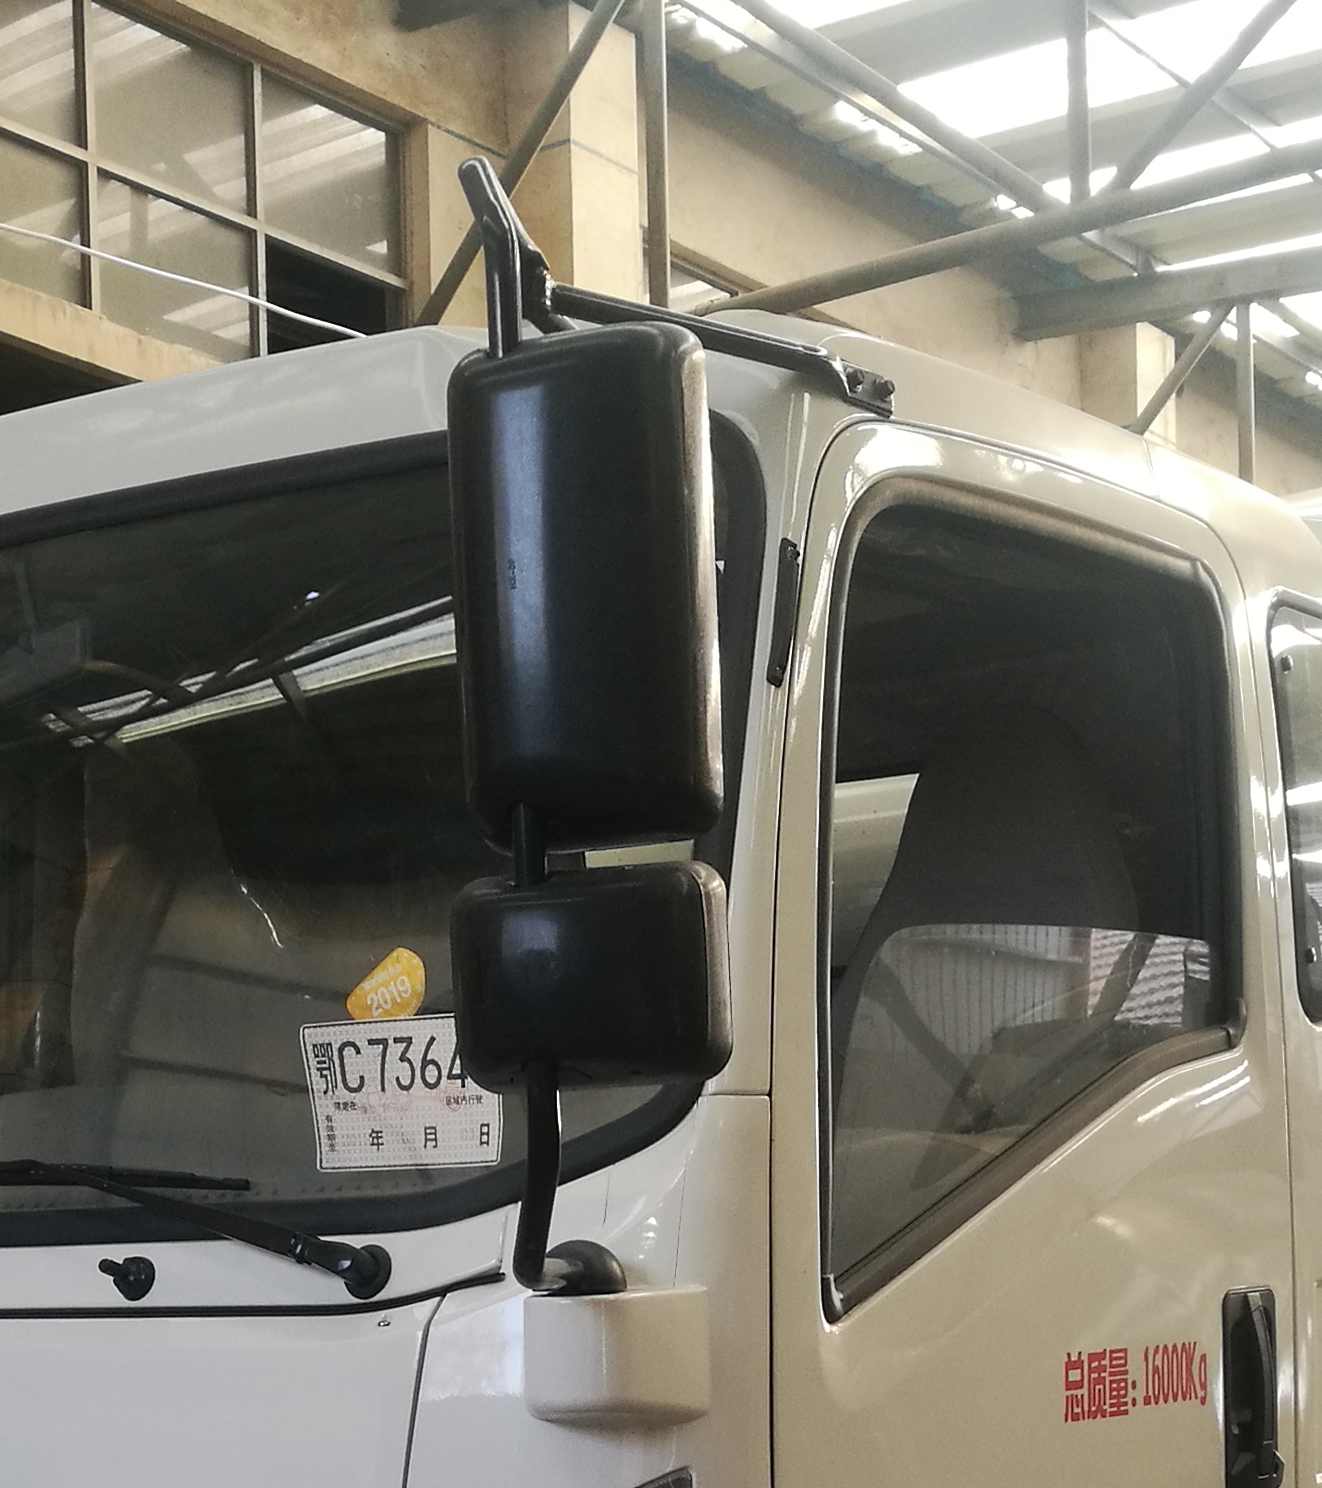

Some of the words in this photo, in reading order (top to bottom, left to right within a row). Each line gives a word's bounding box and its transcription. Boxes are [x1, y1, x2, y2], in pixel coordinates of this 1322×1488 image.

[366, 976, 413, 1017] 2019
[369, 1128, 384, 1150] 年
[423, 1126, 438, 1149] 月
[479, 1123, 490, 1146] 日
